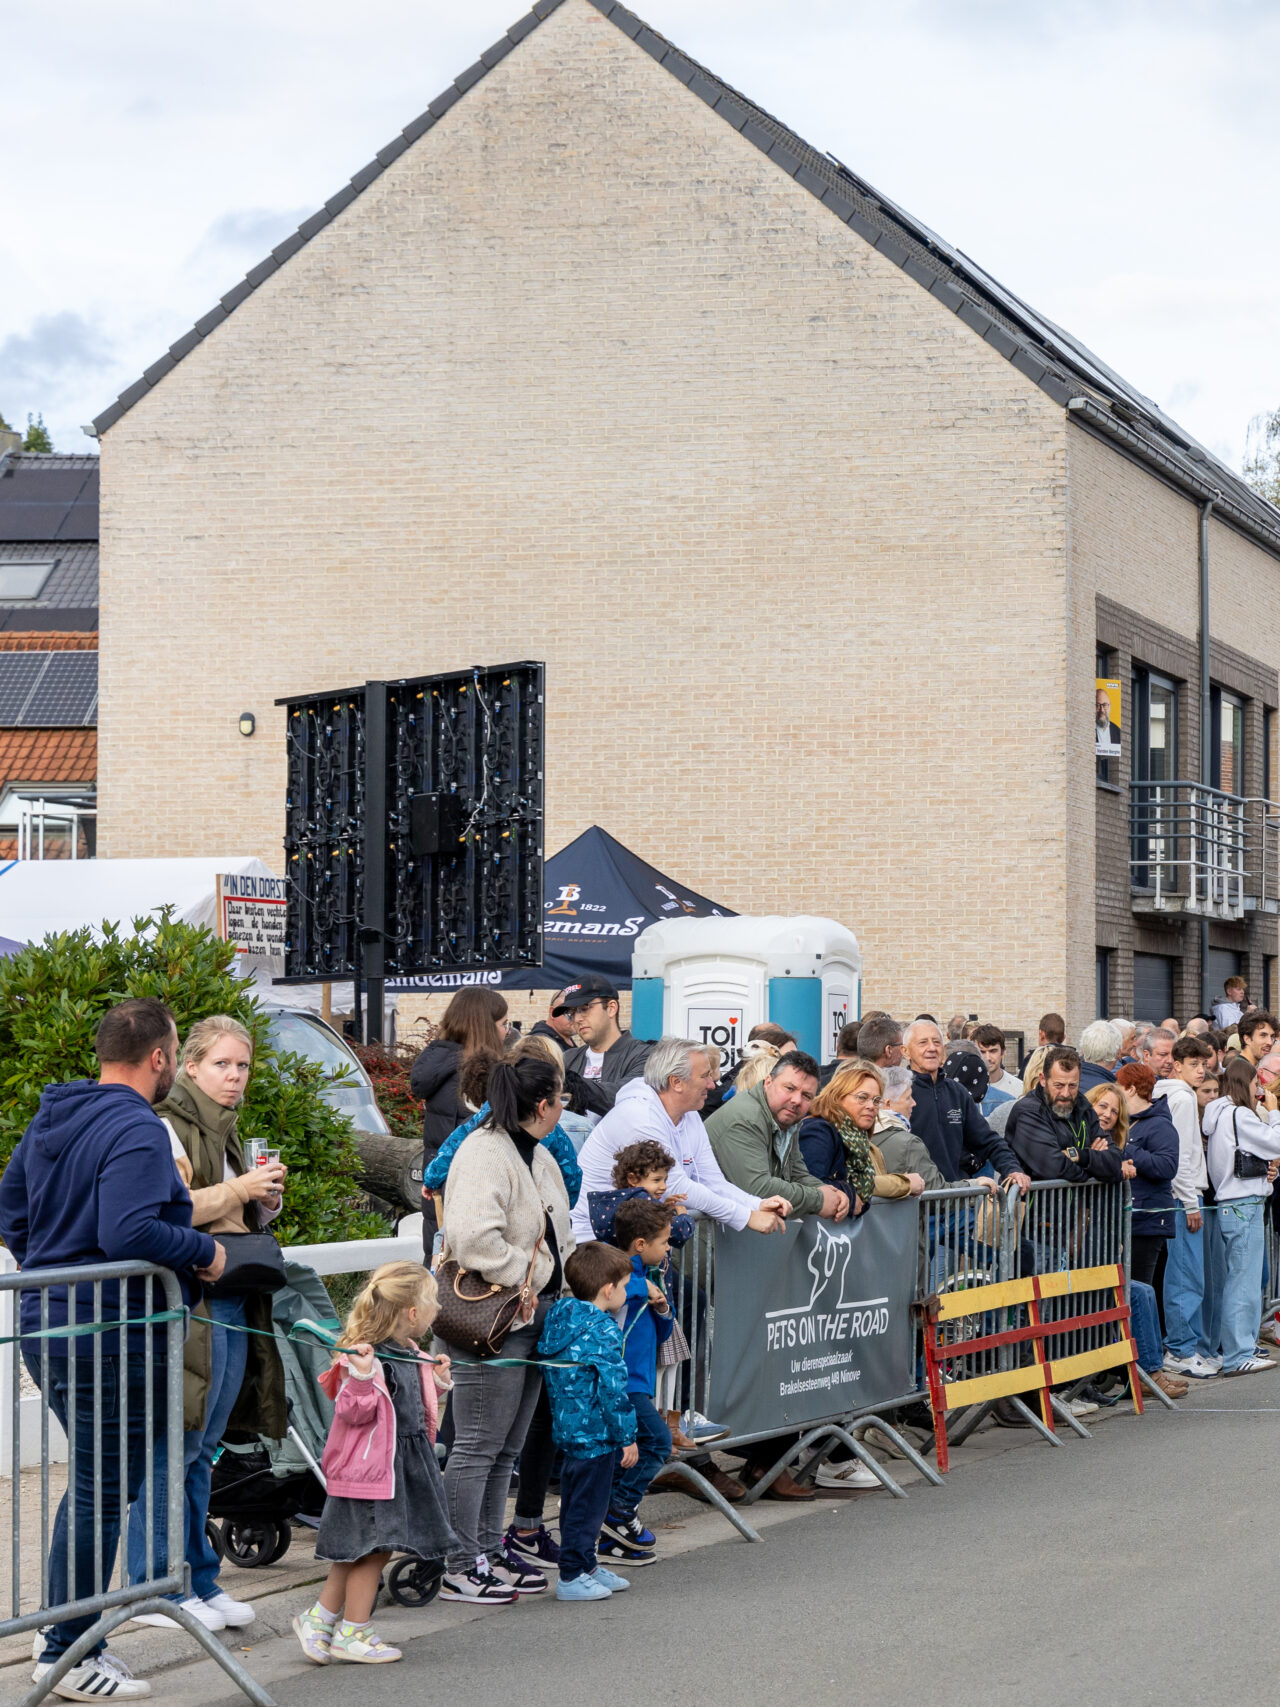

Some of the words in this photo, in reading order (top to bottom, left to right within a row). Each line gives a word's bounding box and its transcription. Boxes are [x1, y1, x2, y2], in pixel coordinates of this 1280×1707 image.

[241, 876, 256, 896] DEN
[228, 901, 241, 914] Daar
[580, 903, 607, 913] 1822
[252, 917, 258, 928] de
[257, 930, 263, 941] de
[767, 1318, 797, 1352] PETS
[799, 1315, 816, 1345] ON
[817, 1312, 850, 1342] THE
[850, 1307, 889, 1339] ROAD
[791, 1360, 801, 1372] Uw
[802, 1350, 853, 1371] dierenspeciaalzaak
[780, 1374, 831, 1396] Brakelsesteenweg
[840, 1368, 861, 1383] Ninove
